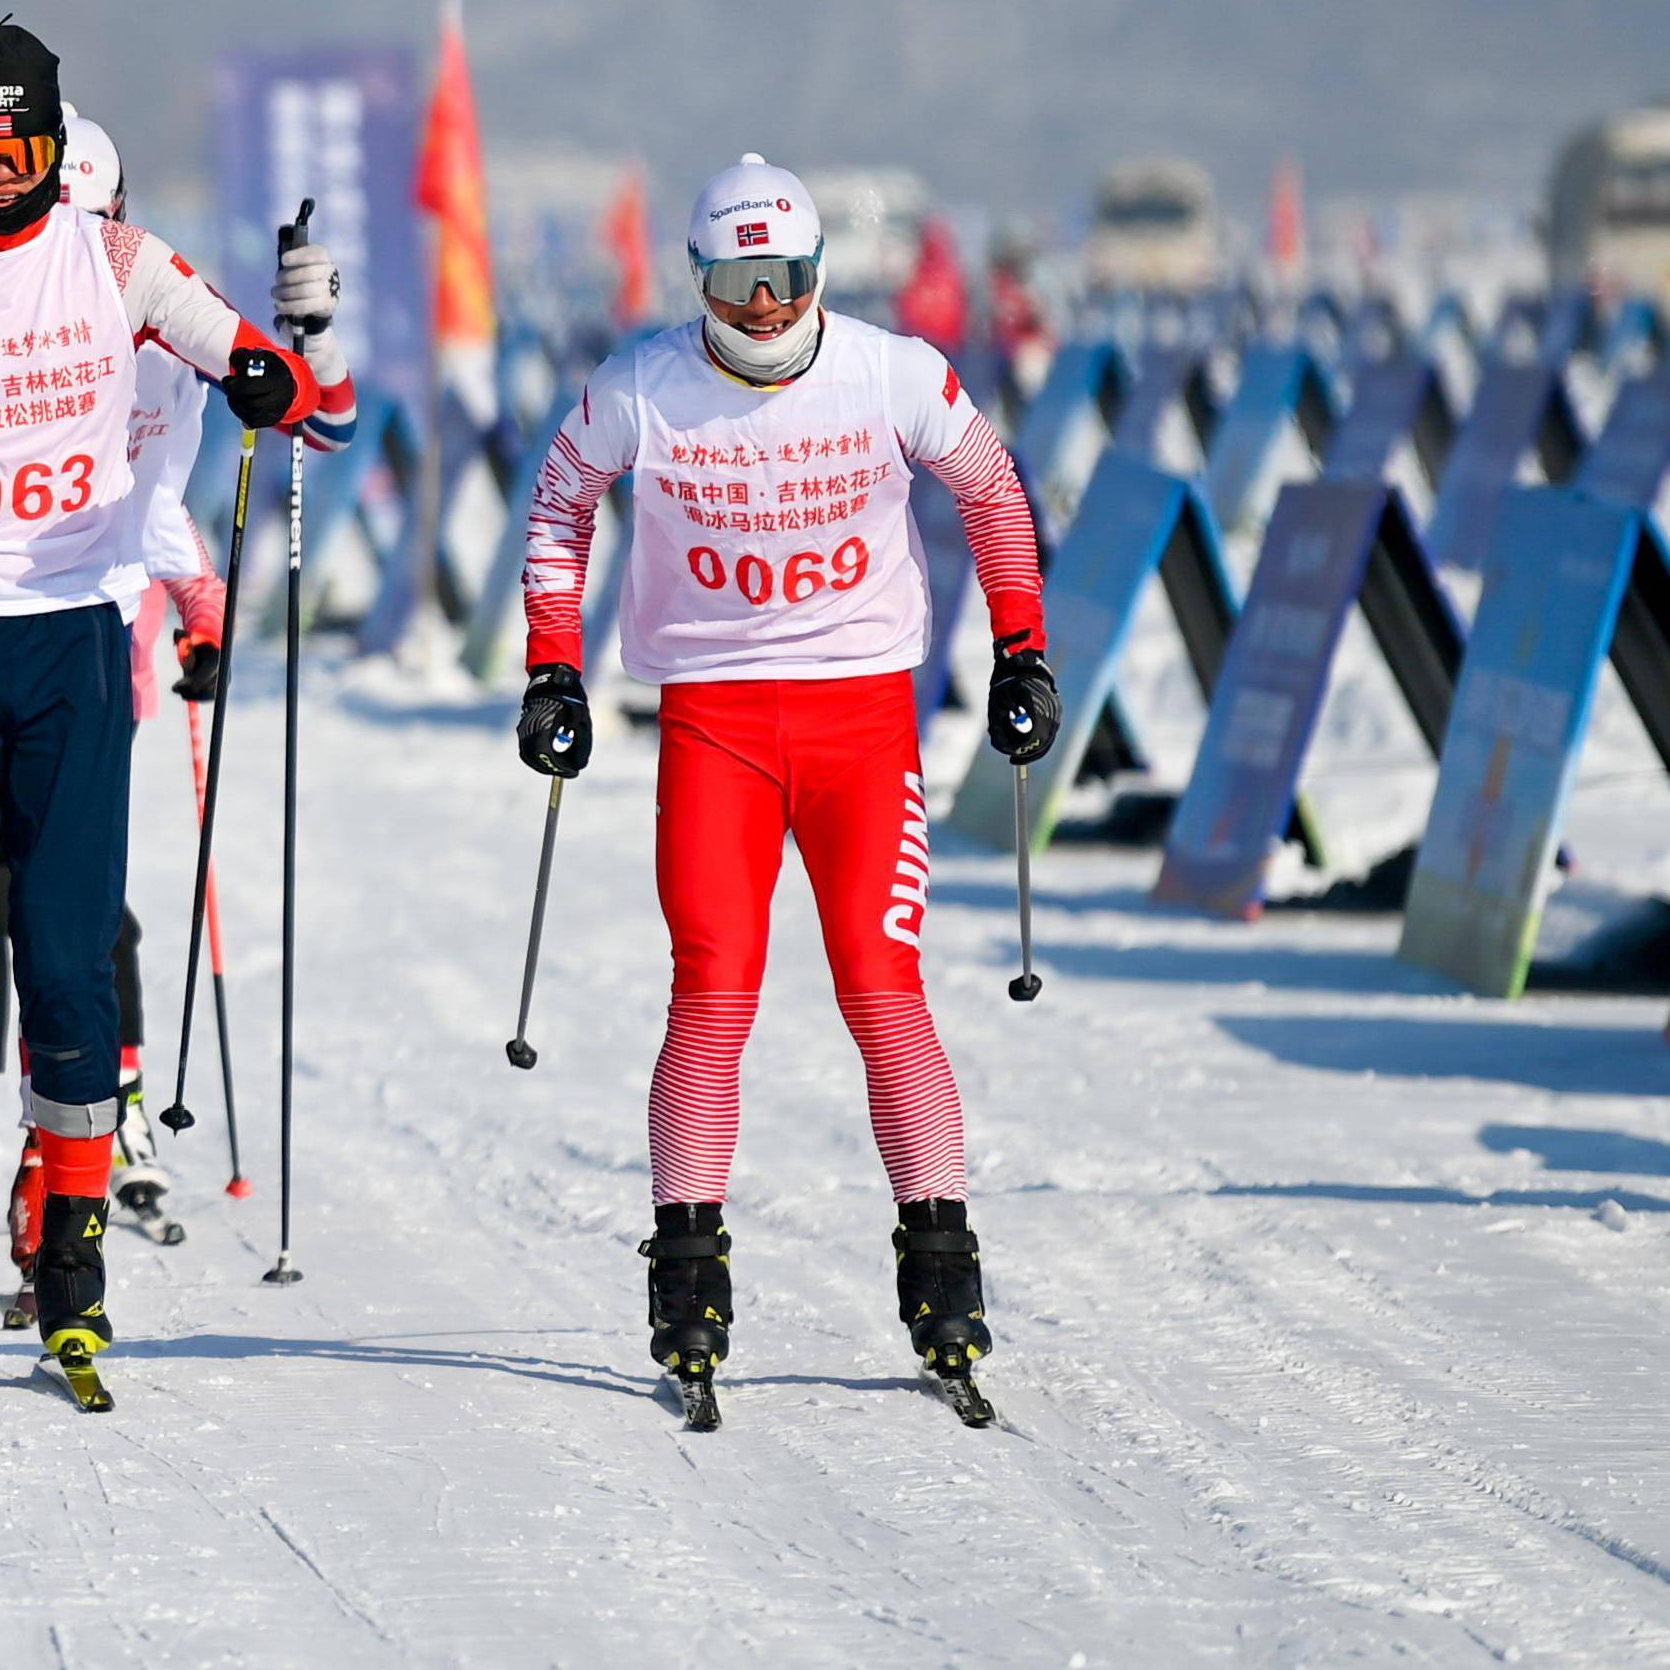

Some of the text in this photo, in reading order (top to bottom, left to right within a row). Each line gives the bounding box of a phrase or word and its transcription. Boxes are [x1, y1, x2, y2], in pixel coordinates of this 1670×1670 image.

[709, 199, 773, 222] SpareBank
[1, 317, 93, 358] 逐梦冰雪情
[671, 428, 873, 468] 魅力松花江 逐梦冰雪情
[684, 493, 869, 533] 滑冰马拉松挑战赛
[687, 536, 870, 606] 0069
